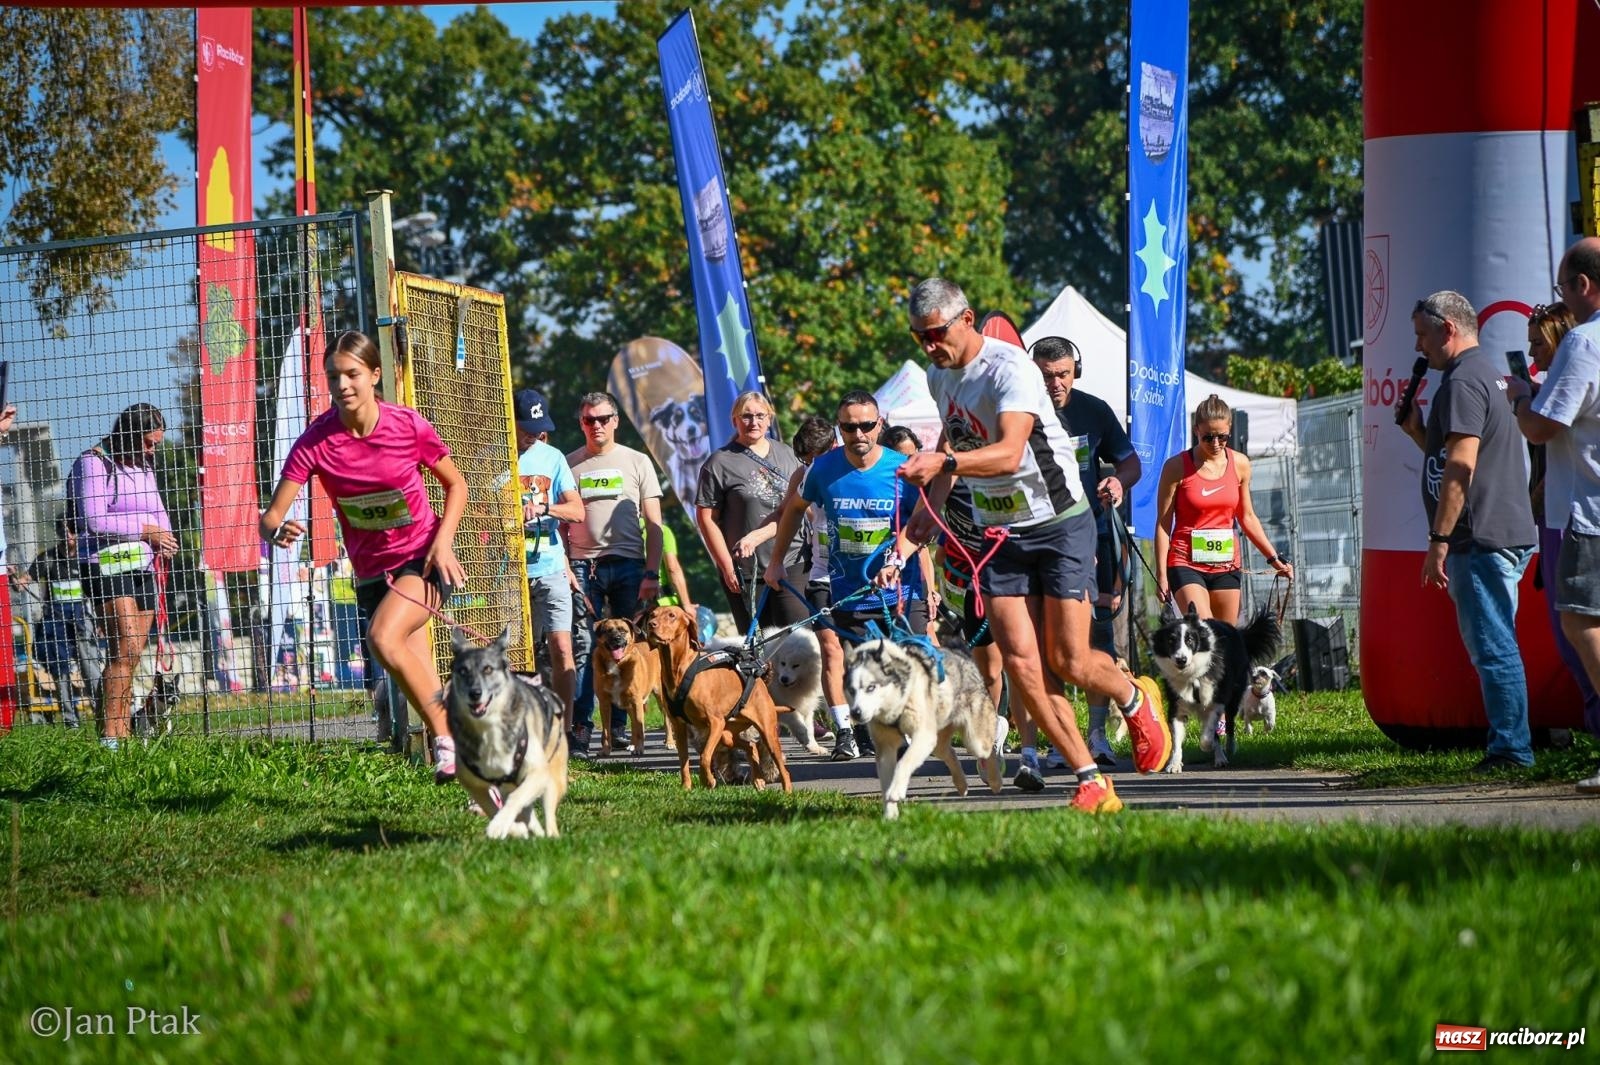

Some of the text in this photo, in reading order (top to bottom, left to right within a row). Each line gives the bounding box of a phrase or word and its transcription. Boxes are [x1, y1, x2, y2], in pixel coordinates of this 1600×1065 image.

[592, 478, 609, 487] 79
[832, 498, 895, 510] TENNECO
[984, 495, 1015, 511] 100
[362, 506, 387, 520] 99
[854, 530, 874, 542] 97
[1206, 540, 1222, 551] 98
